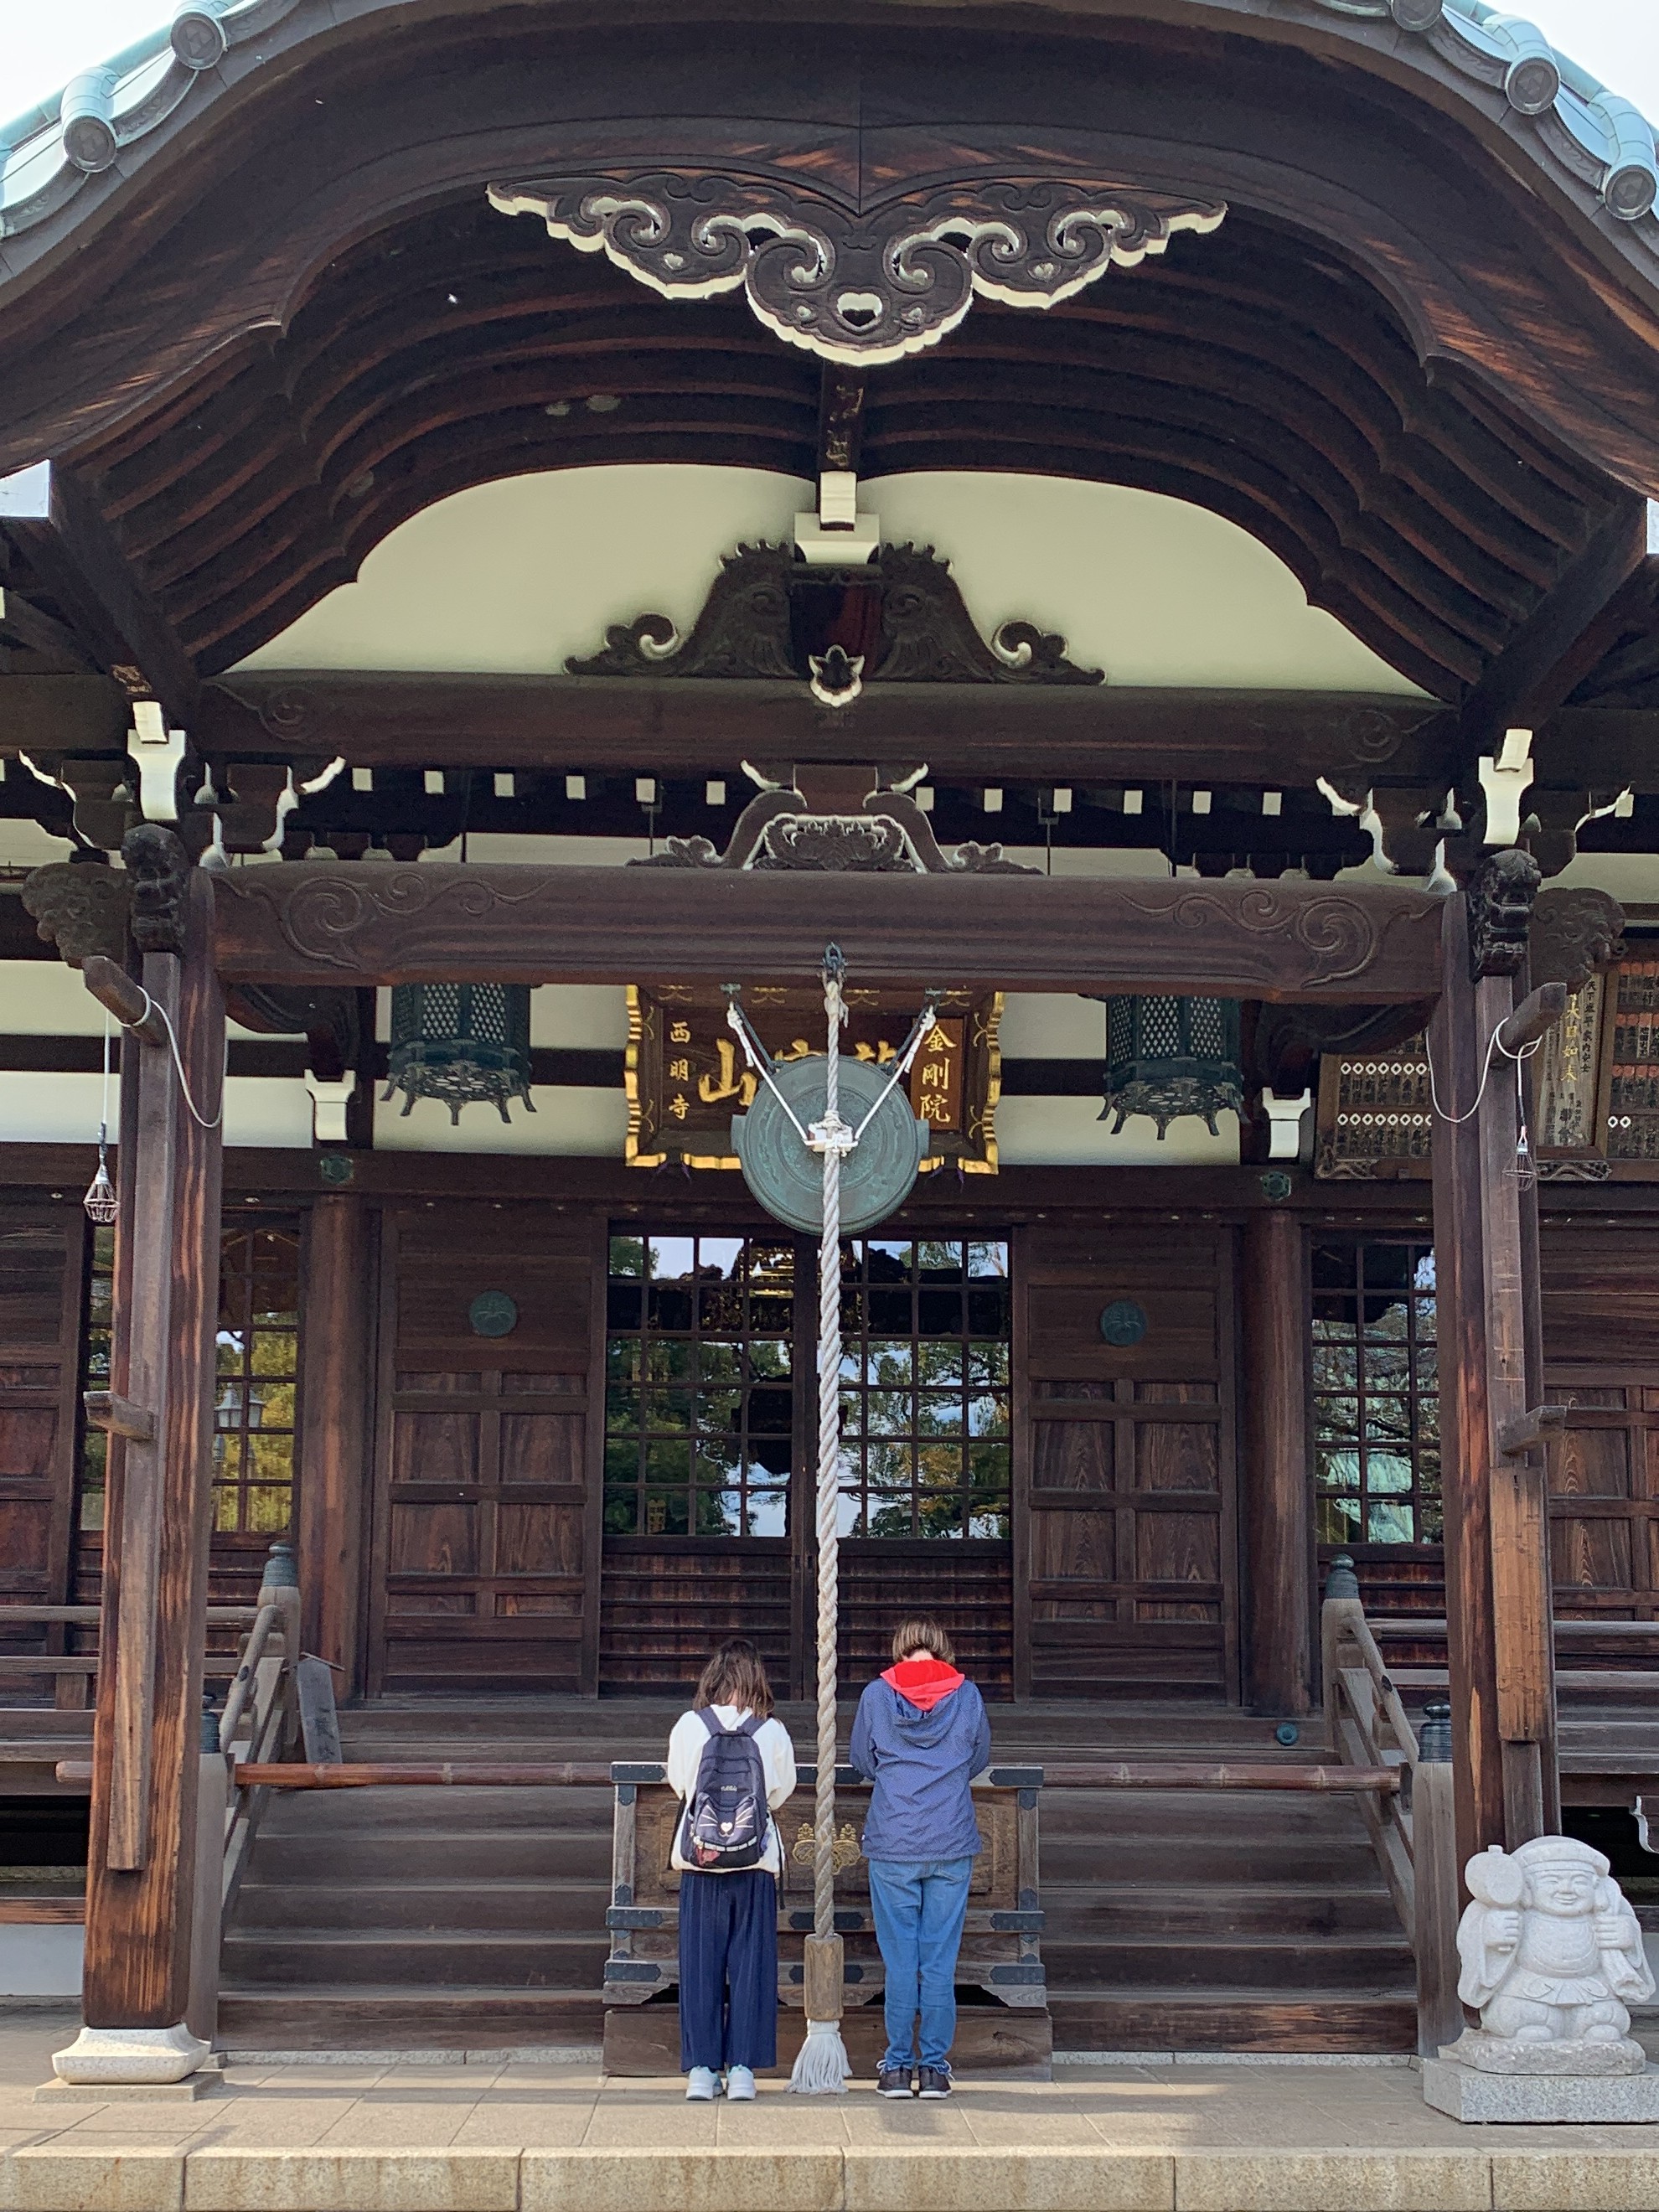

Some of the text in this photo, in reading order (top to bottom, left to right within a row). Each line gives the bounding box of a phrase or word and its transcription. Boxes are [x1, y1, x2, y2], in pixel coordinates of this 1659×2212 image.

[669, 1021, 691, 1120] 西明寺
[919, 1024, 958, 1124] 金剛院
